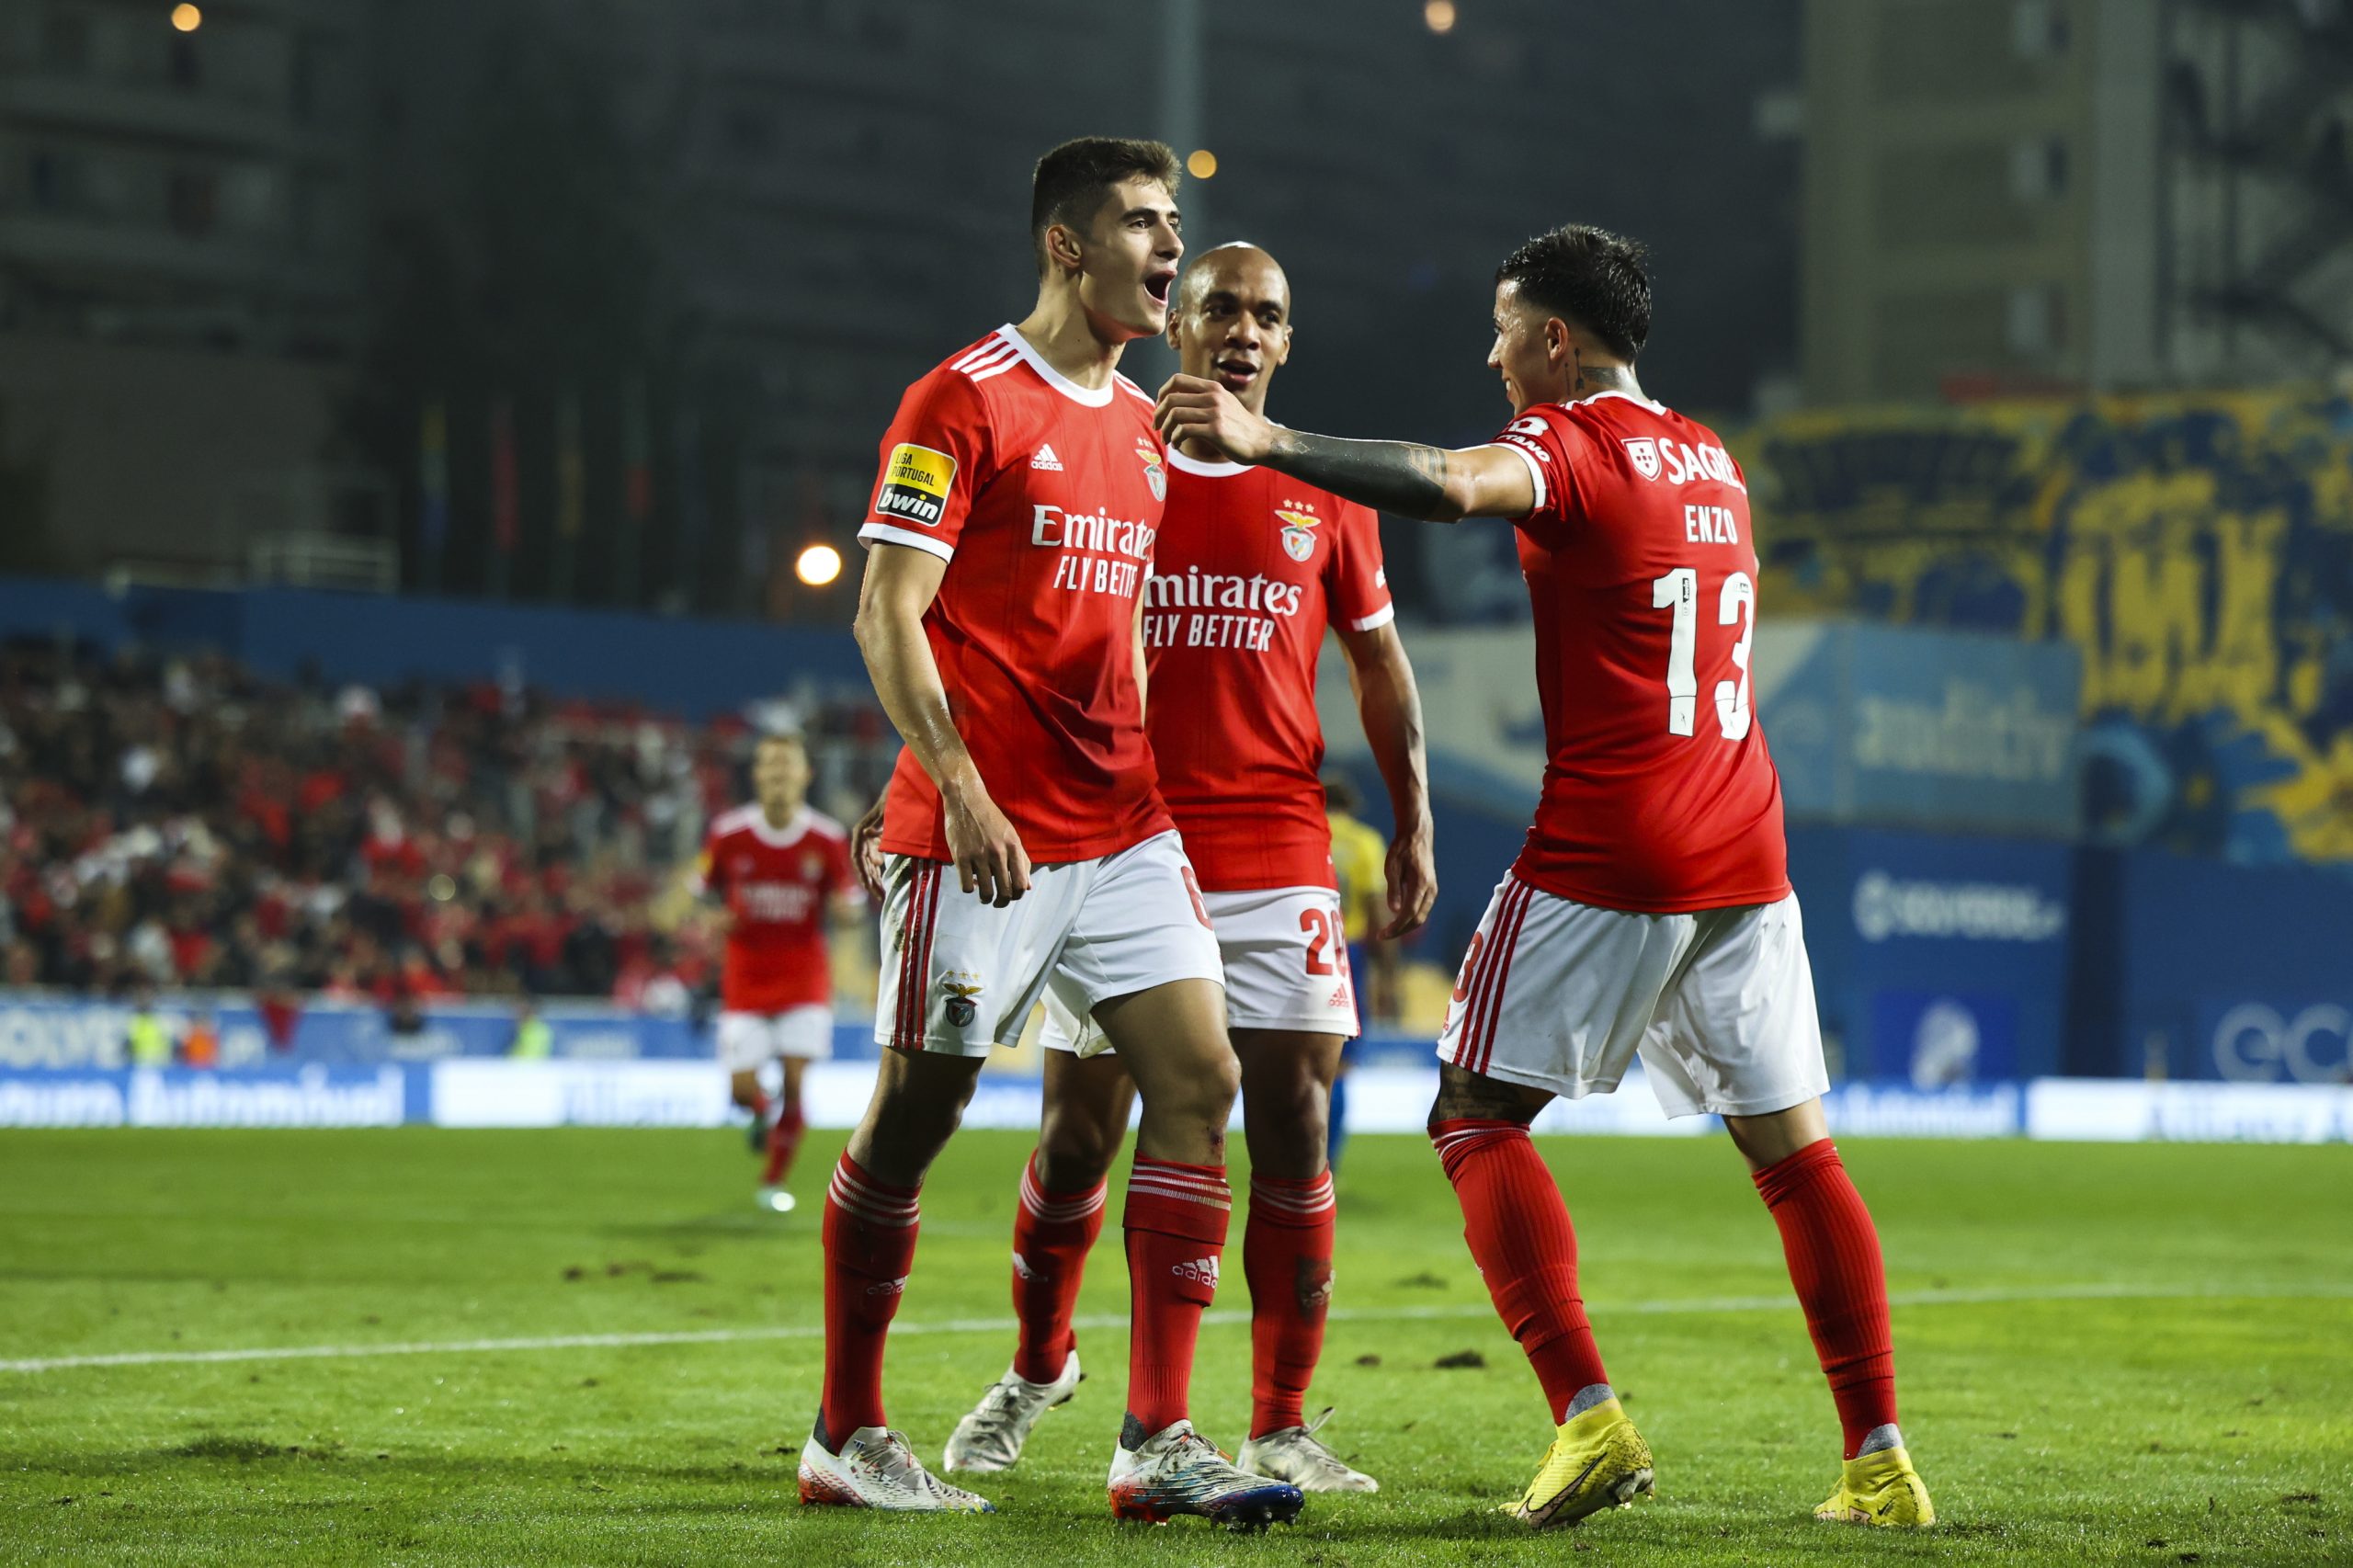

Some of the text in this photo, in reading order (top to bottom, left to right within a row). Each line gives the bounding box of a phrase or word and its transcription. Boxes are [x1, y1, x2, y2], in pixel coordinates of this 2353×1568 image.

[892, 466, 935, 487] PORTUGAL
[895, 452, 913, 466] LIGA
[1030, 460, 1063, 472] adidas
[879, 487, 939, 520] bwin
[1031, 505, 1156, 561] Emirate
[1684, 504, 1738, 545] ENZO
[1053, 555, 1139, 599] FLY BETTE
[1143, 564, 1302, 617] mirates
[1142, 614, 1276, 653] FLY BETTER
[1653, 567, 1755, 741] 13
[1172, 1265, 1218, 1290] adida
